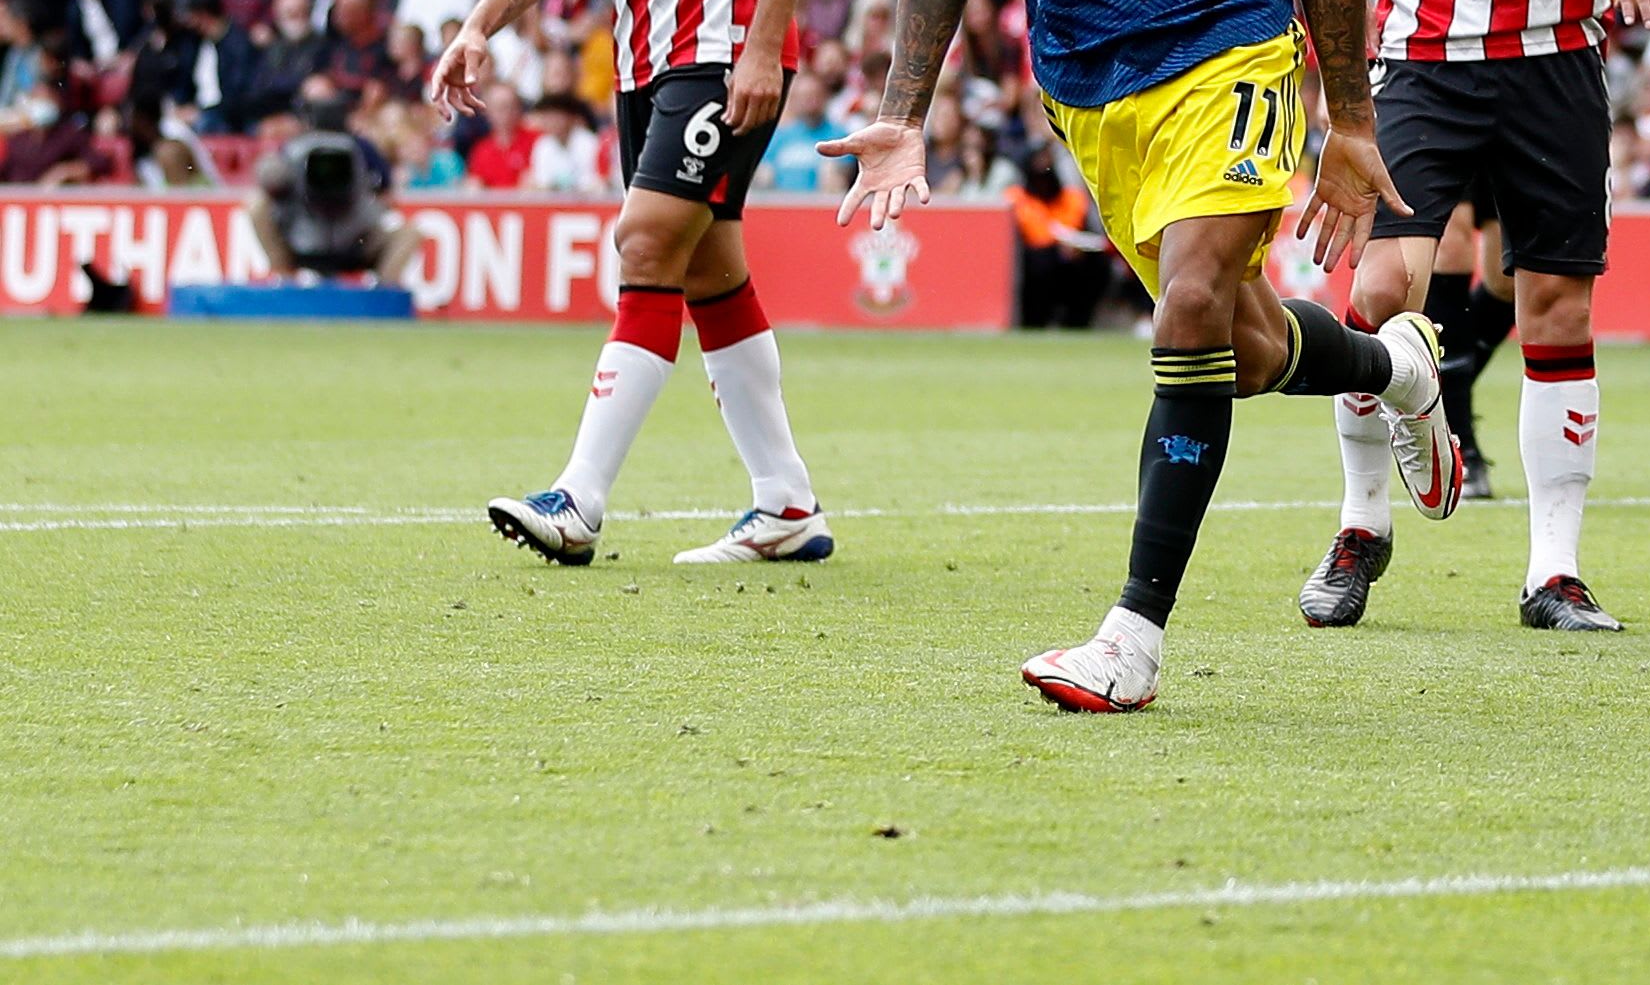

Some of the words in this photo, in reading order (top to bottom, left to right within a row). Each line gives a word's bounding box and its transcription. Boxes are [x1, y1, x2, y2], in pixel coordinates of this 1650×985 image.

[683, 100, 724, 158] 6
[1229, 81, 1279, 156] 11
[1222, 170, 1264, 186] adidas
